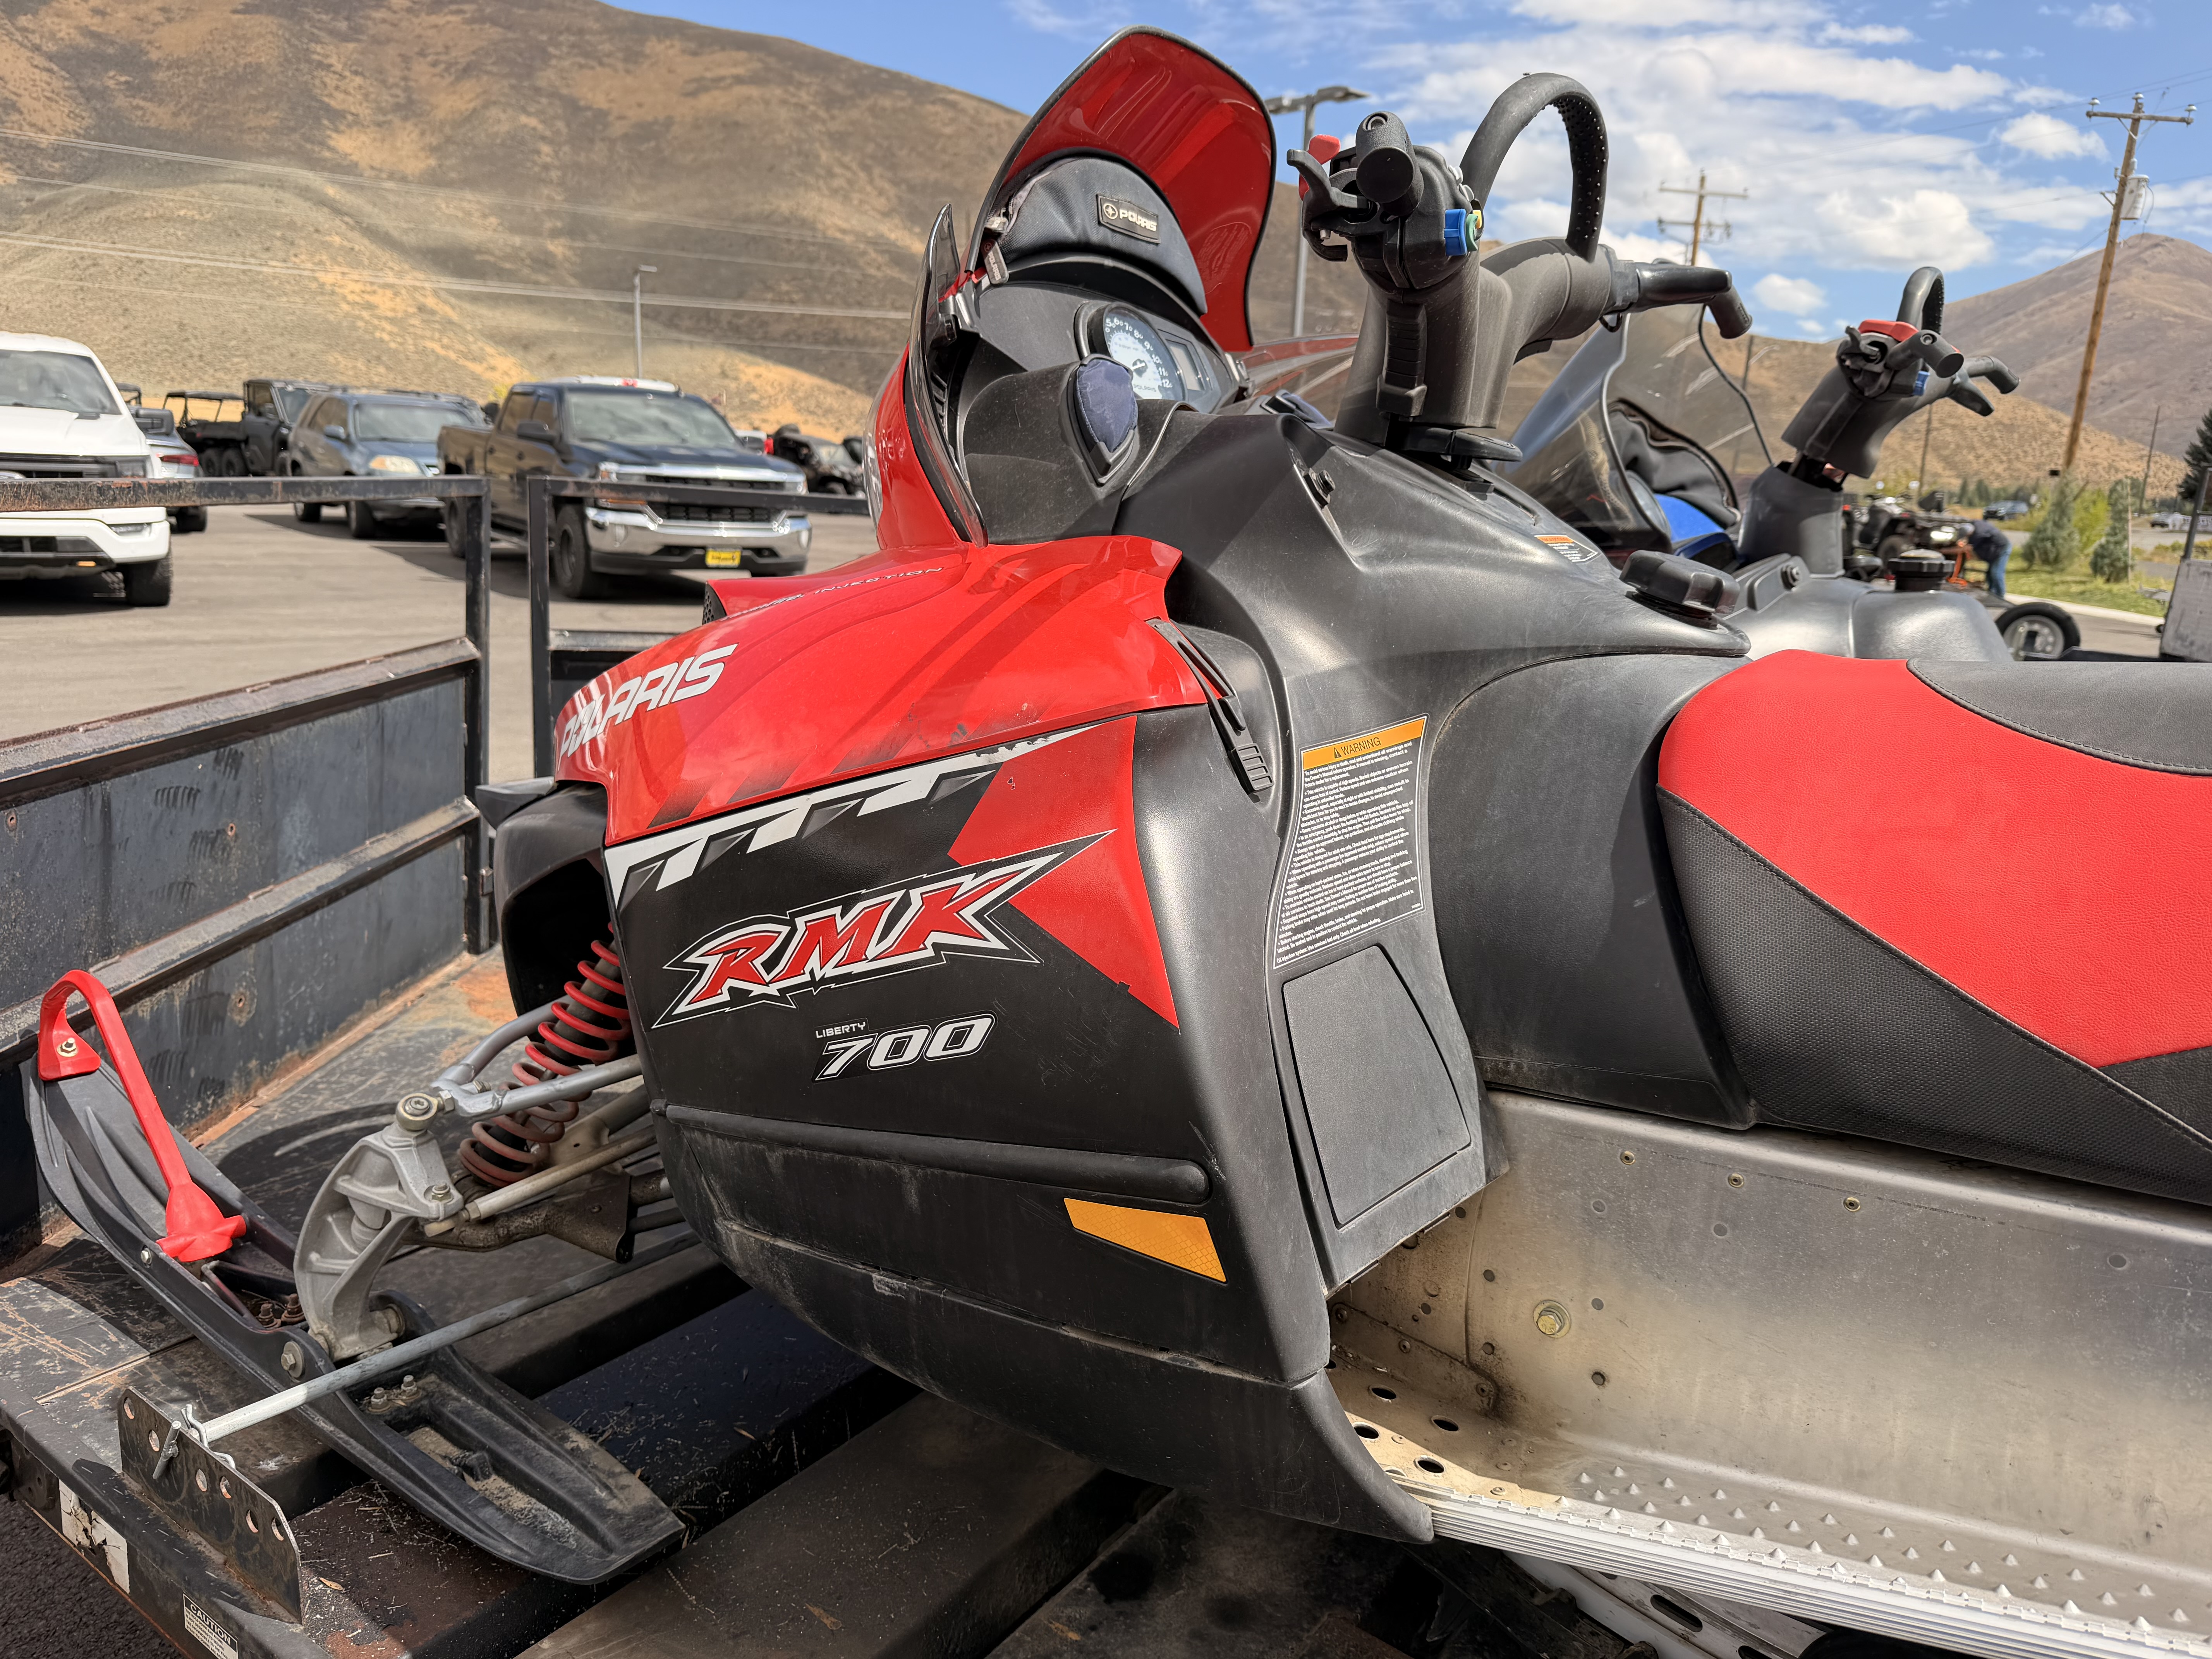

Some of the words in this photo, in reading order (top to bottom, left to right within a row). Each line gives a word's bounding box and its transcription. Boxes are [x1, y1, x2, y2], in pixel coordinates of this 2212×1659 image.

[1119, 209, 1157, 232] POLARIS
[814, 567, 943, 594] INJECTION
[558, 642, 738, 772] POLARIS
[1341, 737, 1381, 755] WARNING
[1386, 745, 1403, 753] warnings
[675, 856, 1057, 1013] RMK
[816, 1022, 866, 1039] LIBERTY
[816, 1014, 995, 1080] 700
[190, 1604, 231, 1645] CAUTION
